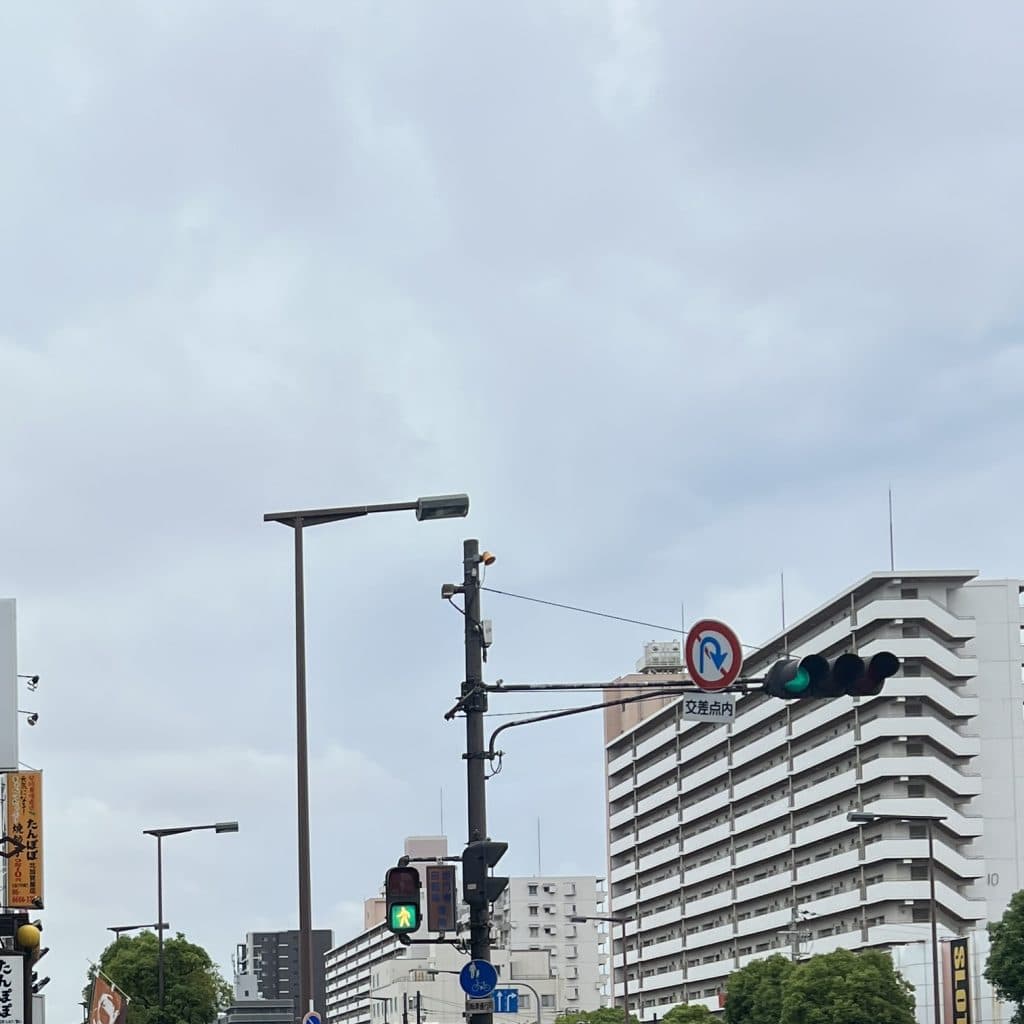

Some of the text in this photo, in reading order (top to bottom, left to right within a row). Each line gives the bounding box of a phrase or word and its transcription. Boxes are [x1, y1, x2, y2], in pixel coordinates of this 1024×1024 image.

[686, 700, 733, 716] 交差点内
[27, 818, 38, 861] たんぽぽ
[986, 873, 1000, 886] 10
